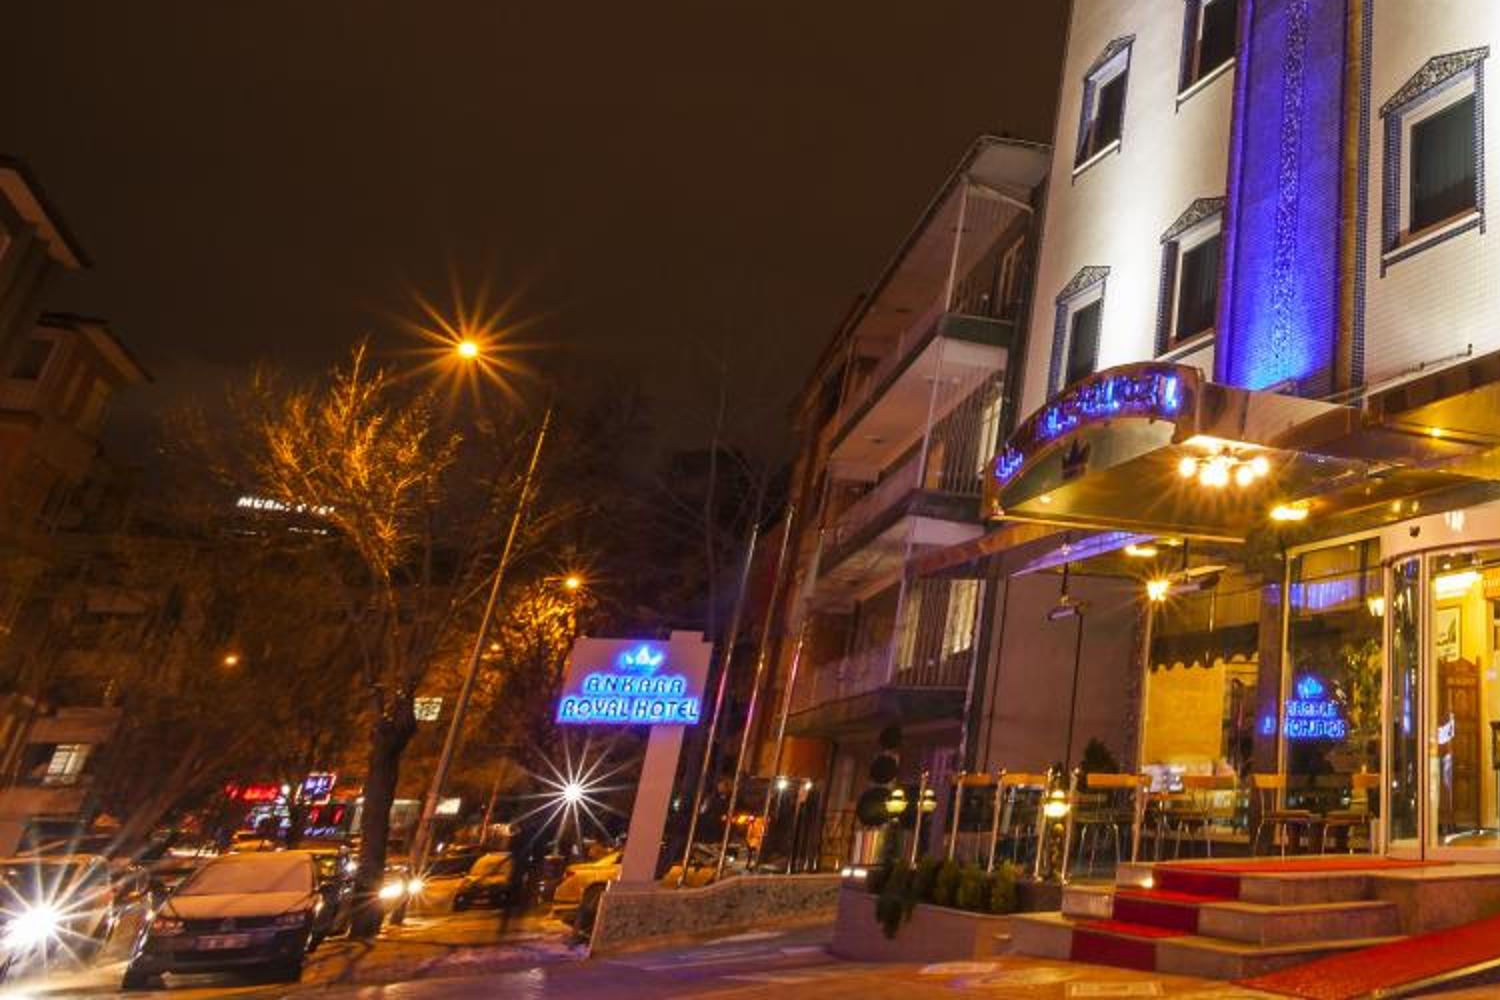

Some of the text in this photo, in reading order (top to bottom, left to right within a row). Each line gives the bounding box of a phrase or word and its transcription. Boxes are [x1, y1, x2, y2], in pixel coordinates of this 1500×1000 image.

[584, 675, 685, 694] ANKARA
[561, 698, 699, 718] ROYAL HOTEL
